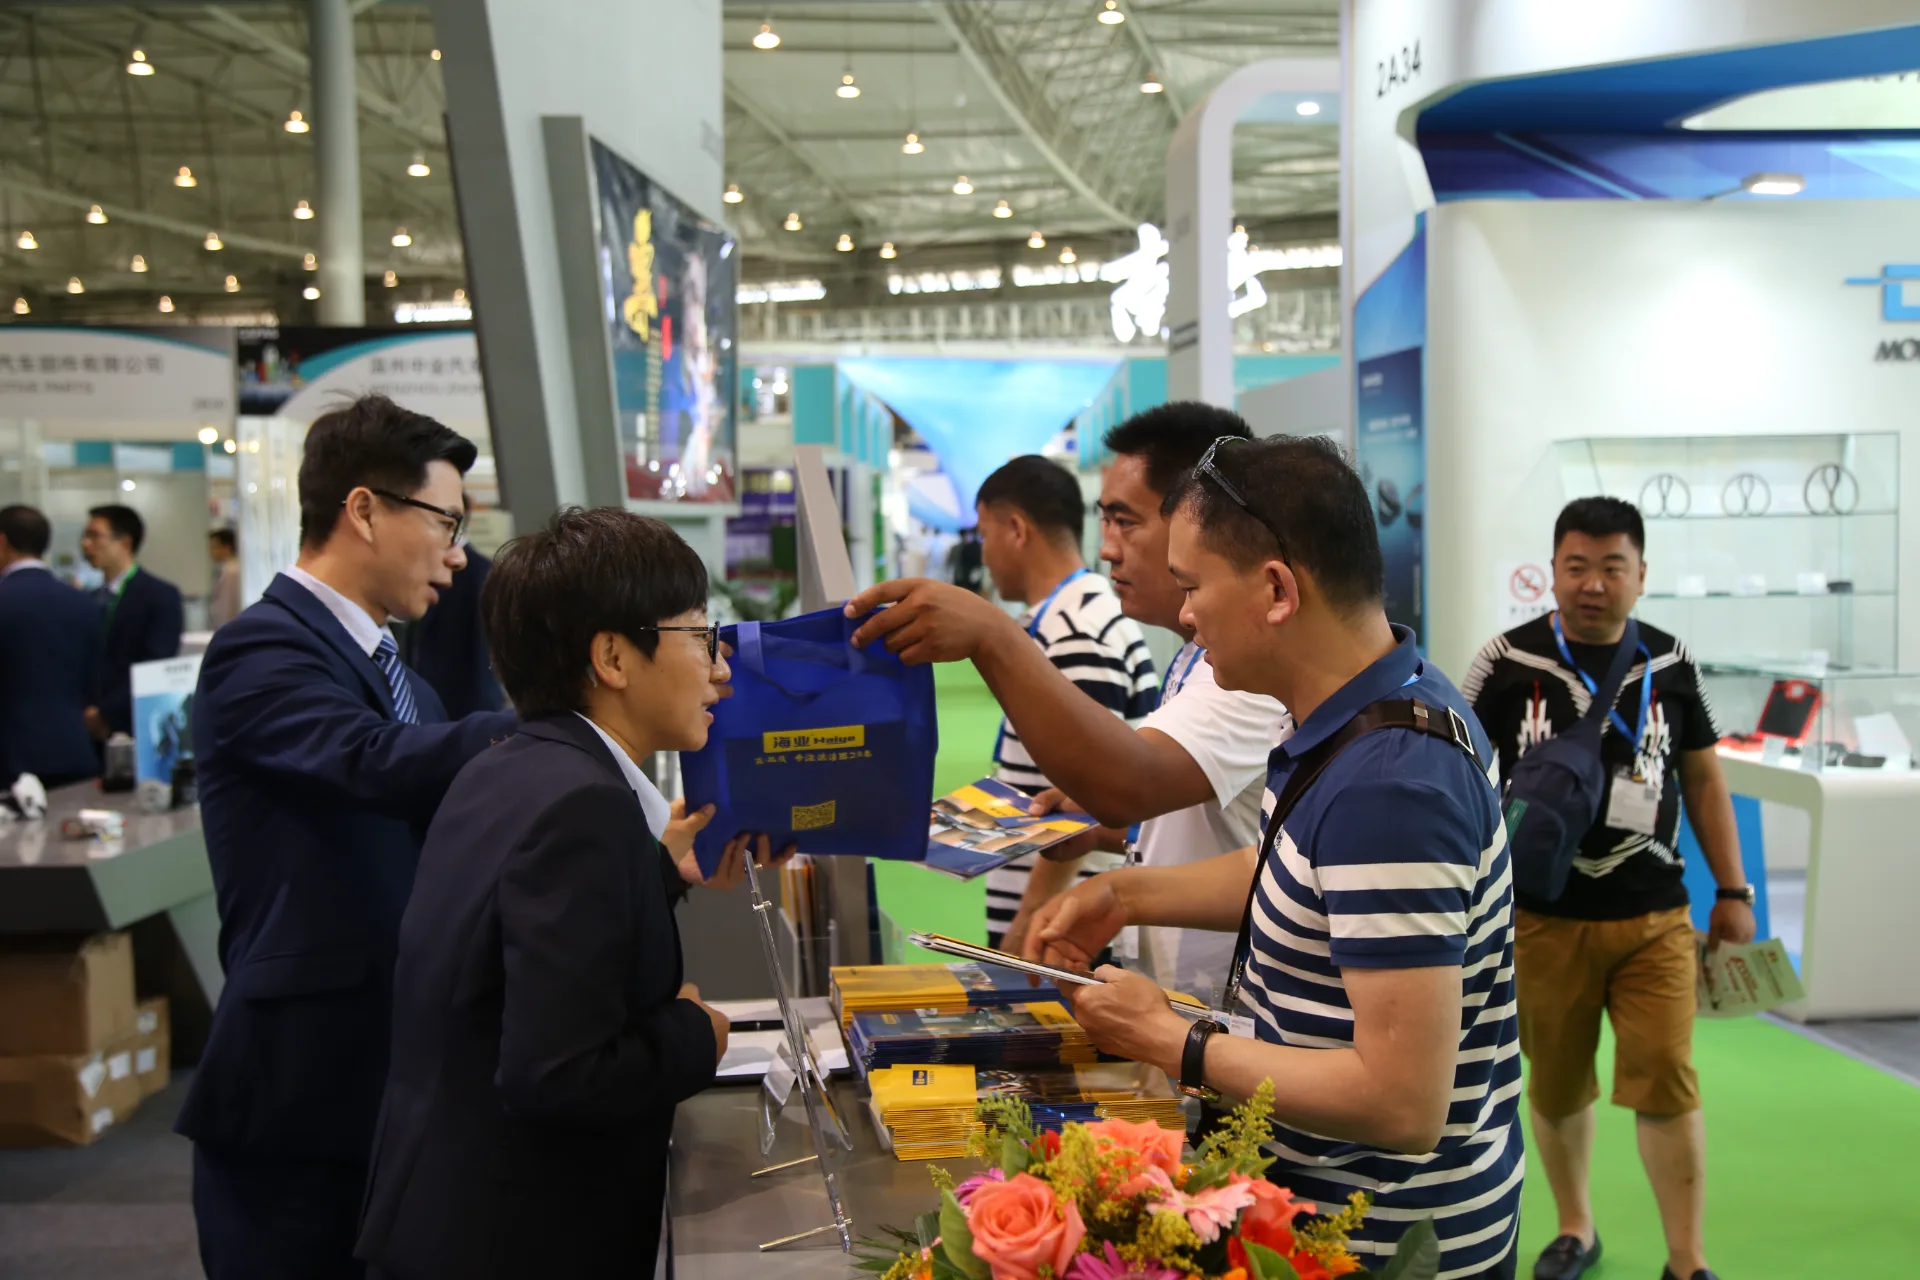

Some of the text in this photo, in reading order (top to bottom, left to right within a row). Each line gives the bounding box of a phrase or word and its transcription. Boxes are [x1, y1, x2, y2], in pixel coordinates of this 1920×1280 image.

[1377, 38, 1422, 98] 2A34
[1874, 338, 1920, 362] MO
[773, 735, 811, 749] 海业
